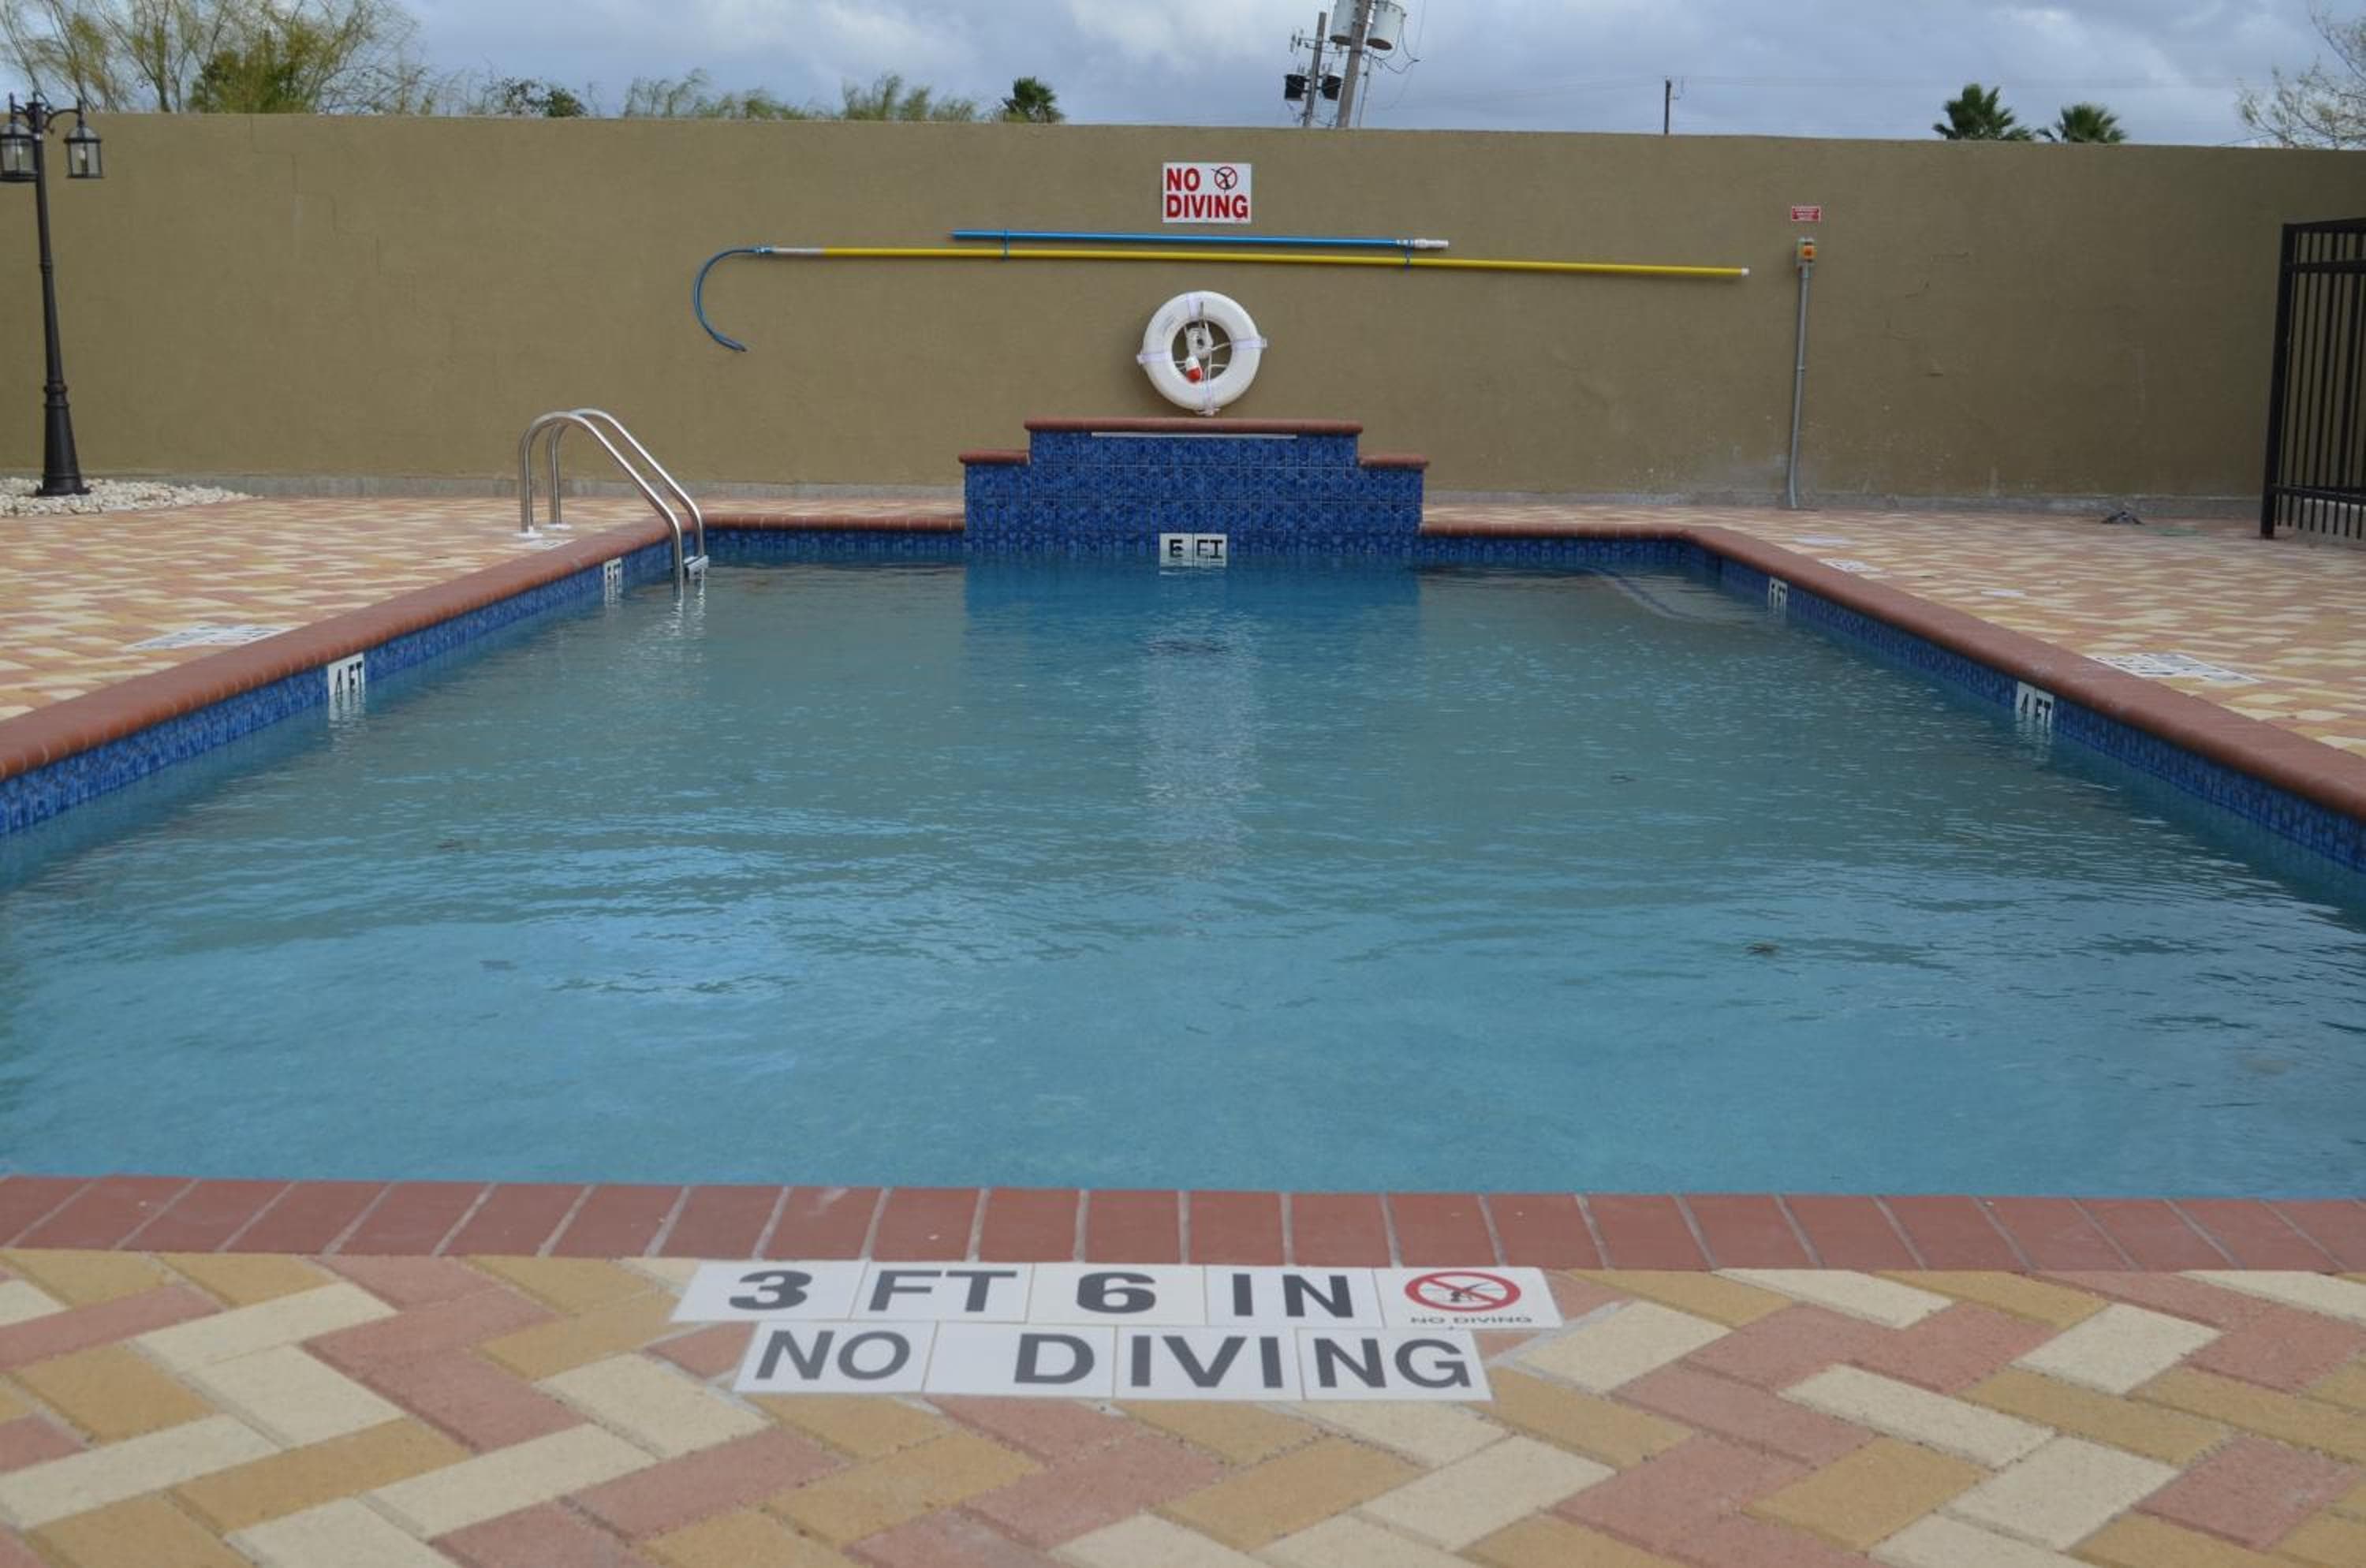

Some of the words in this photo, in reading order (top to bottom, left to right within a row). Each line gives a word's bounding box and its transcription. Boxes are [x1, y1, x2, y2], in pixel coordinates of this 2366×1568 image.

[1166, 168, 1200, 192] NO
[1166, 194, 1248, 218] DIVING
[728, 1269, 813, 1312] 3
[868, 1270, 1017, 1313] FT
[1076, 1271, 1157, 1315] 6
[1232, 1272, 1354, 1319] IN
[1453, 1316, 1533, 1324] DIVING
[755, 1330, 911, 1381] NO
[1013, 1333, 1472, 1390] DIVING
